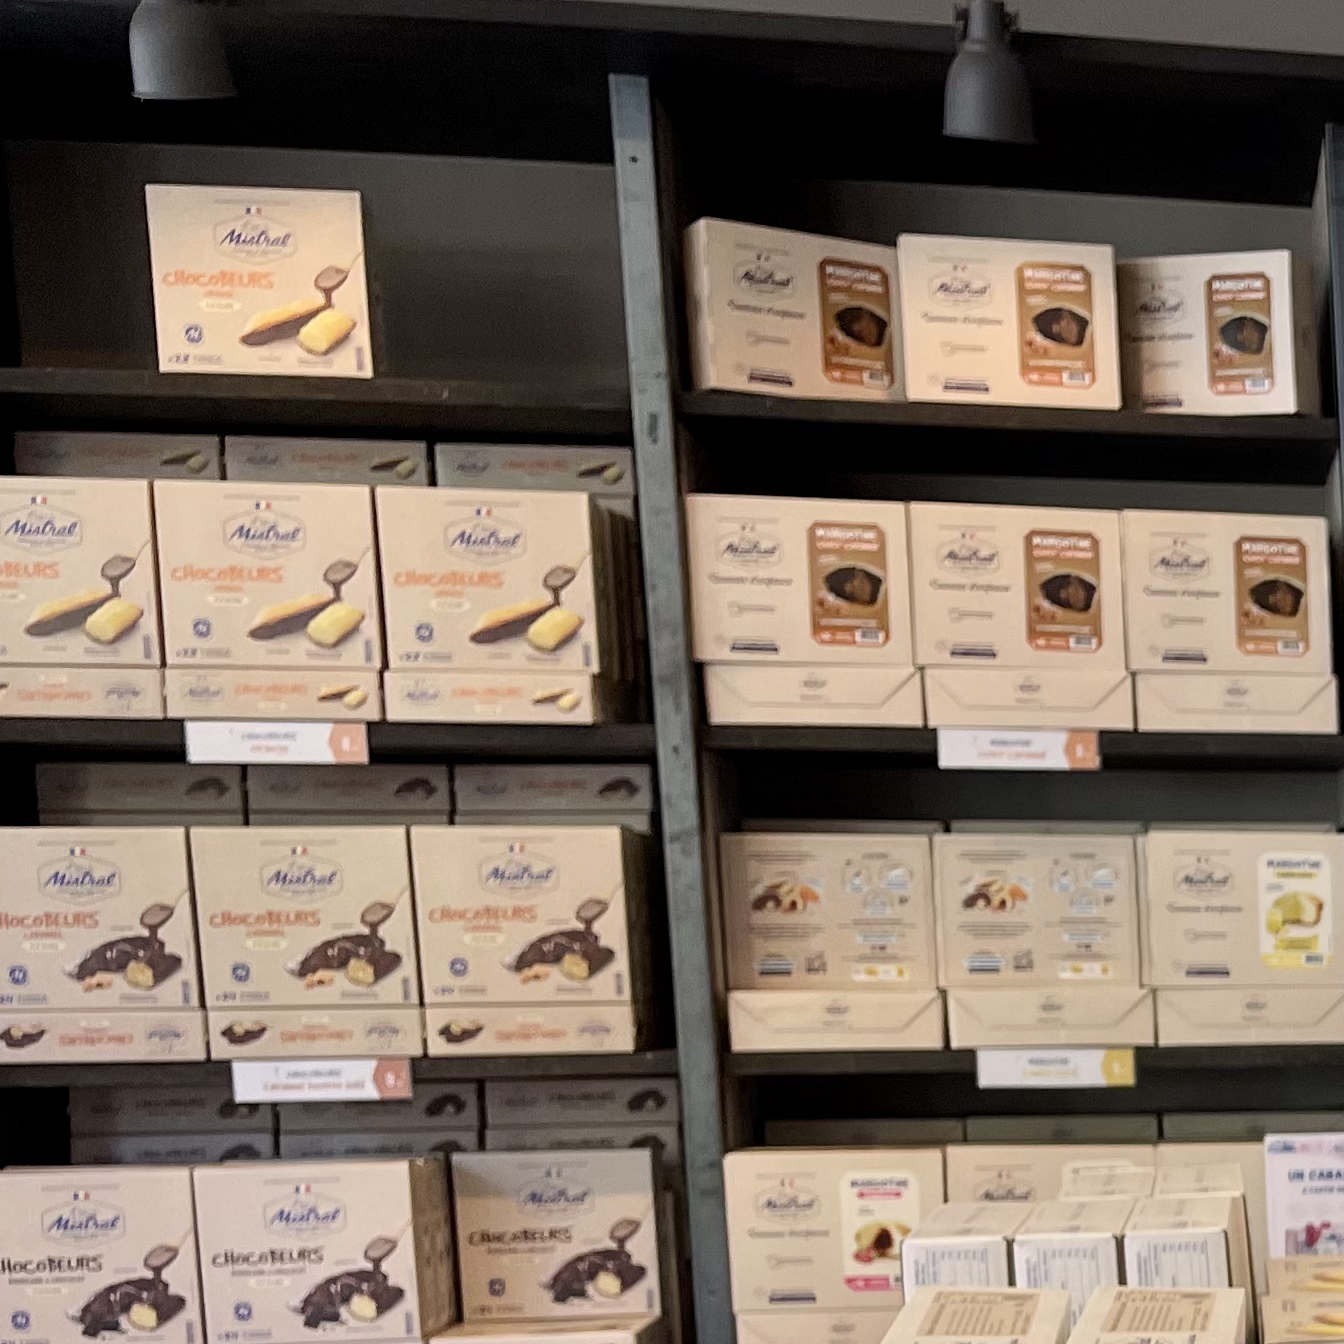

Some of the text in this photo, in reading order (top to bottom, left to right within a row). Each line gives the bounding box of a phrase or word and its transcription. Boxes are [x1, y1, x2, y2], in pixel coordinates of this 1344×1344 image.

[219, 228, 294, 251] Mistral
[4, 518, 79, 539] Mistral
[229, 523, 302, 545] Mistral
[449, 530, 522, 551] Mistral
